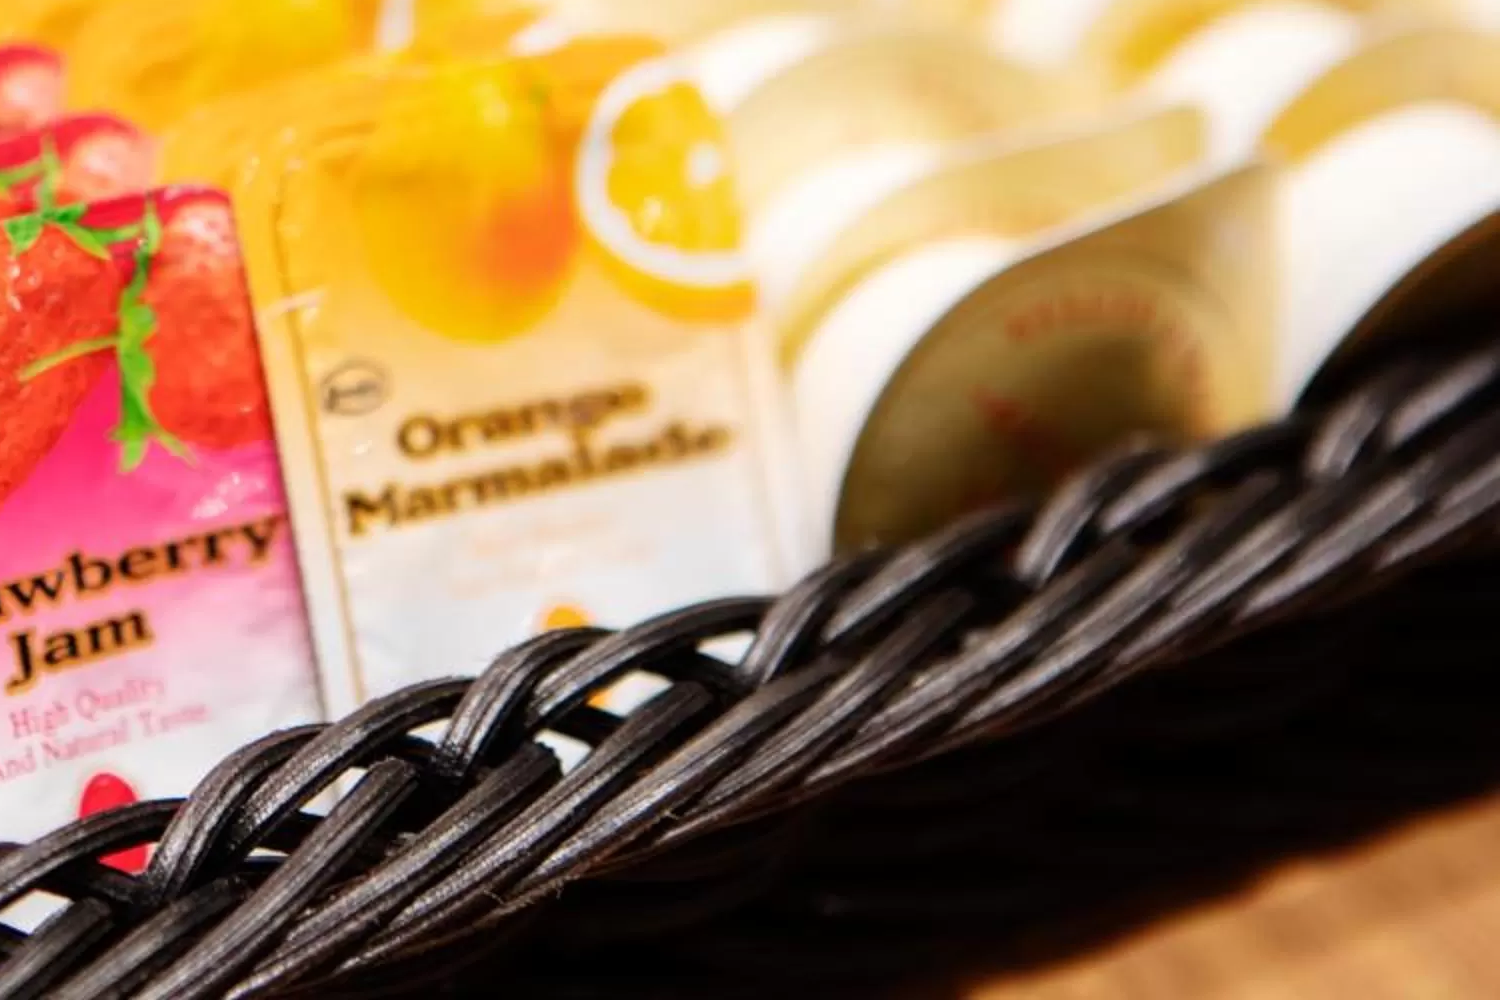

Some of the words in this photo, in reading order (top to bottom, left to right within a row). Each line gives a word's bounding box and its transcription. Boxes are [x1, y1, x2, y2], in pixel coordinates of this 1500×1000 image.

[397, 378, 650, 460] Orange
[344, 421, 732, 537] Marmalade
[5, 608, 153, 696] Jam
